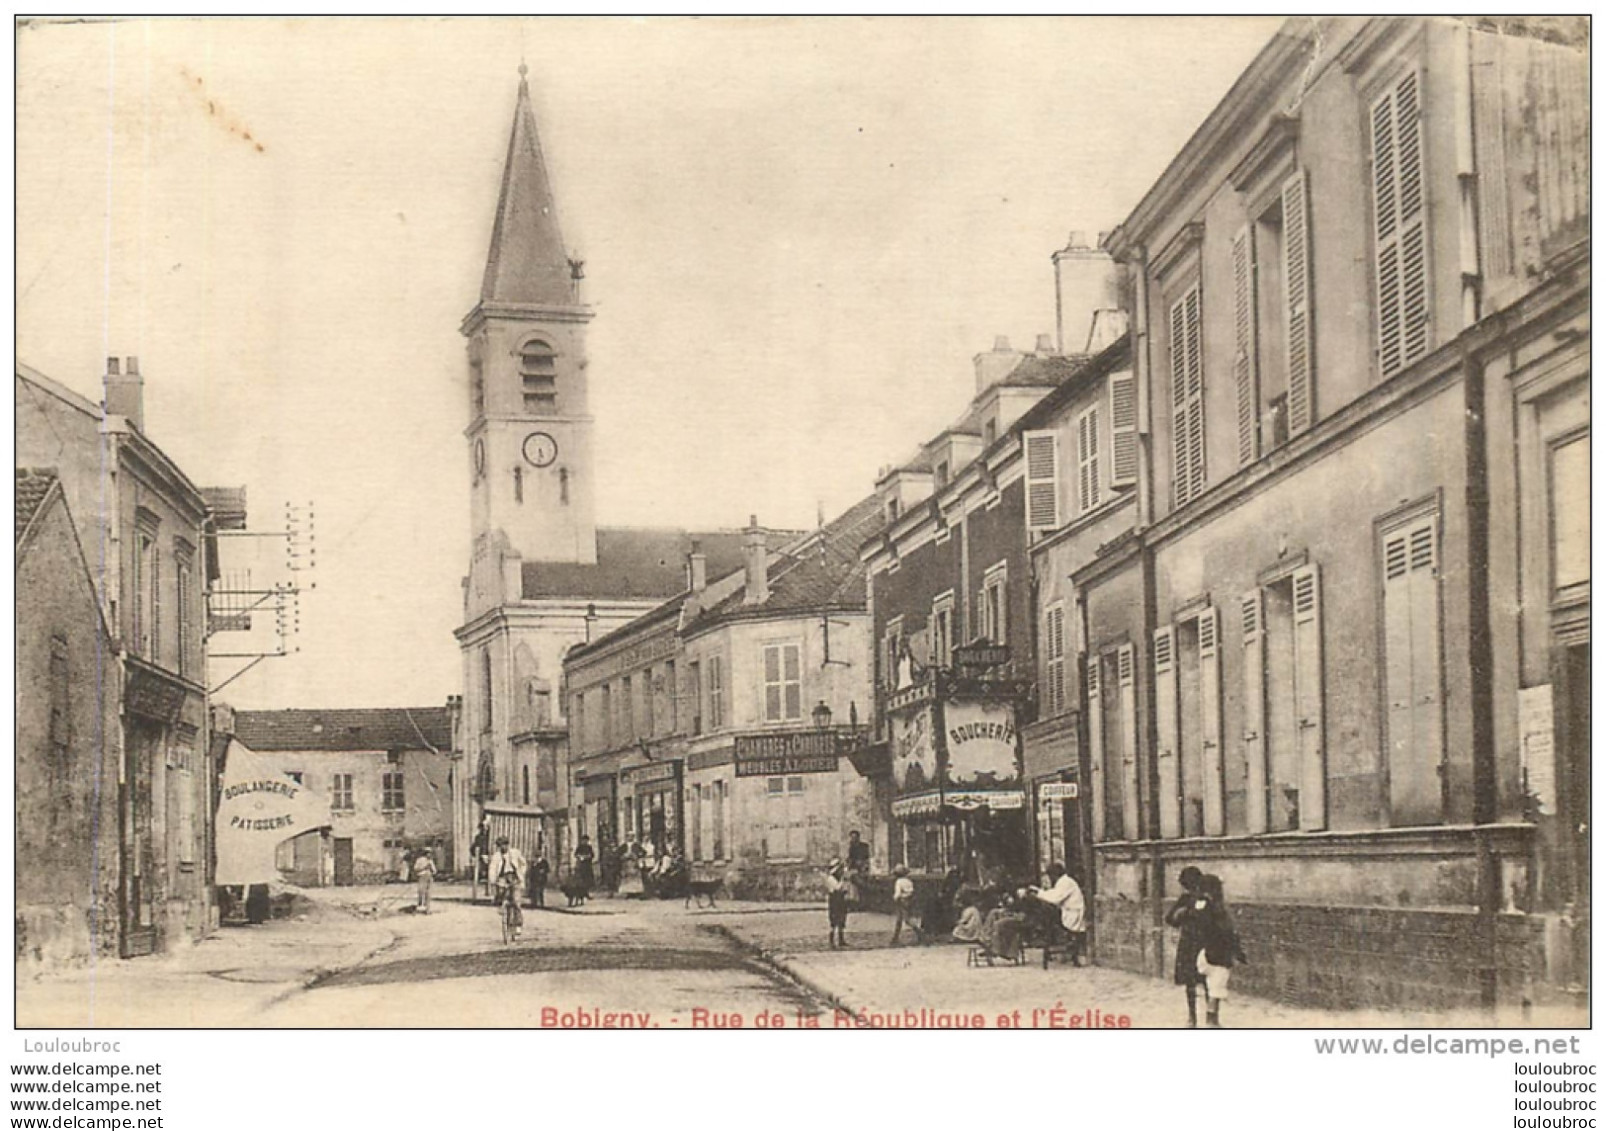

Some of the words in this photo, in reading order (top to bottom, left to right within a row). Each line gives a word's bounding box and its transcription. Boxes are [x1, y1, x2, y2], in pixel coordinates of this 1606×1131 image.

[949, 721, 1014, 745] BOUCHERIE
[224, 780, 299, 800] BOULANGERIE
[230, 813, 295, 831] PATISSERIE
